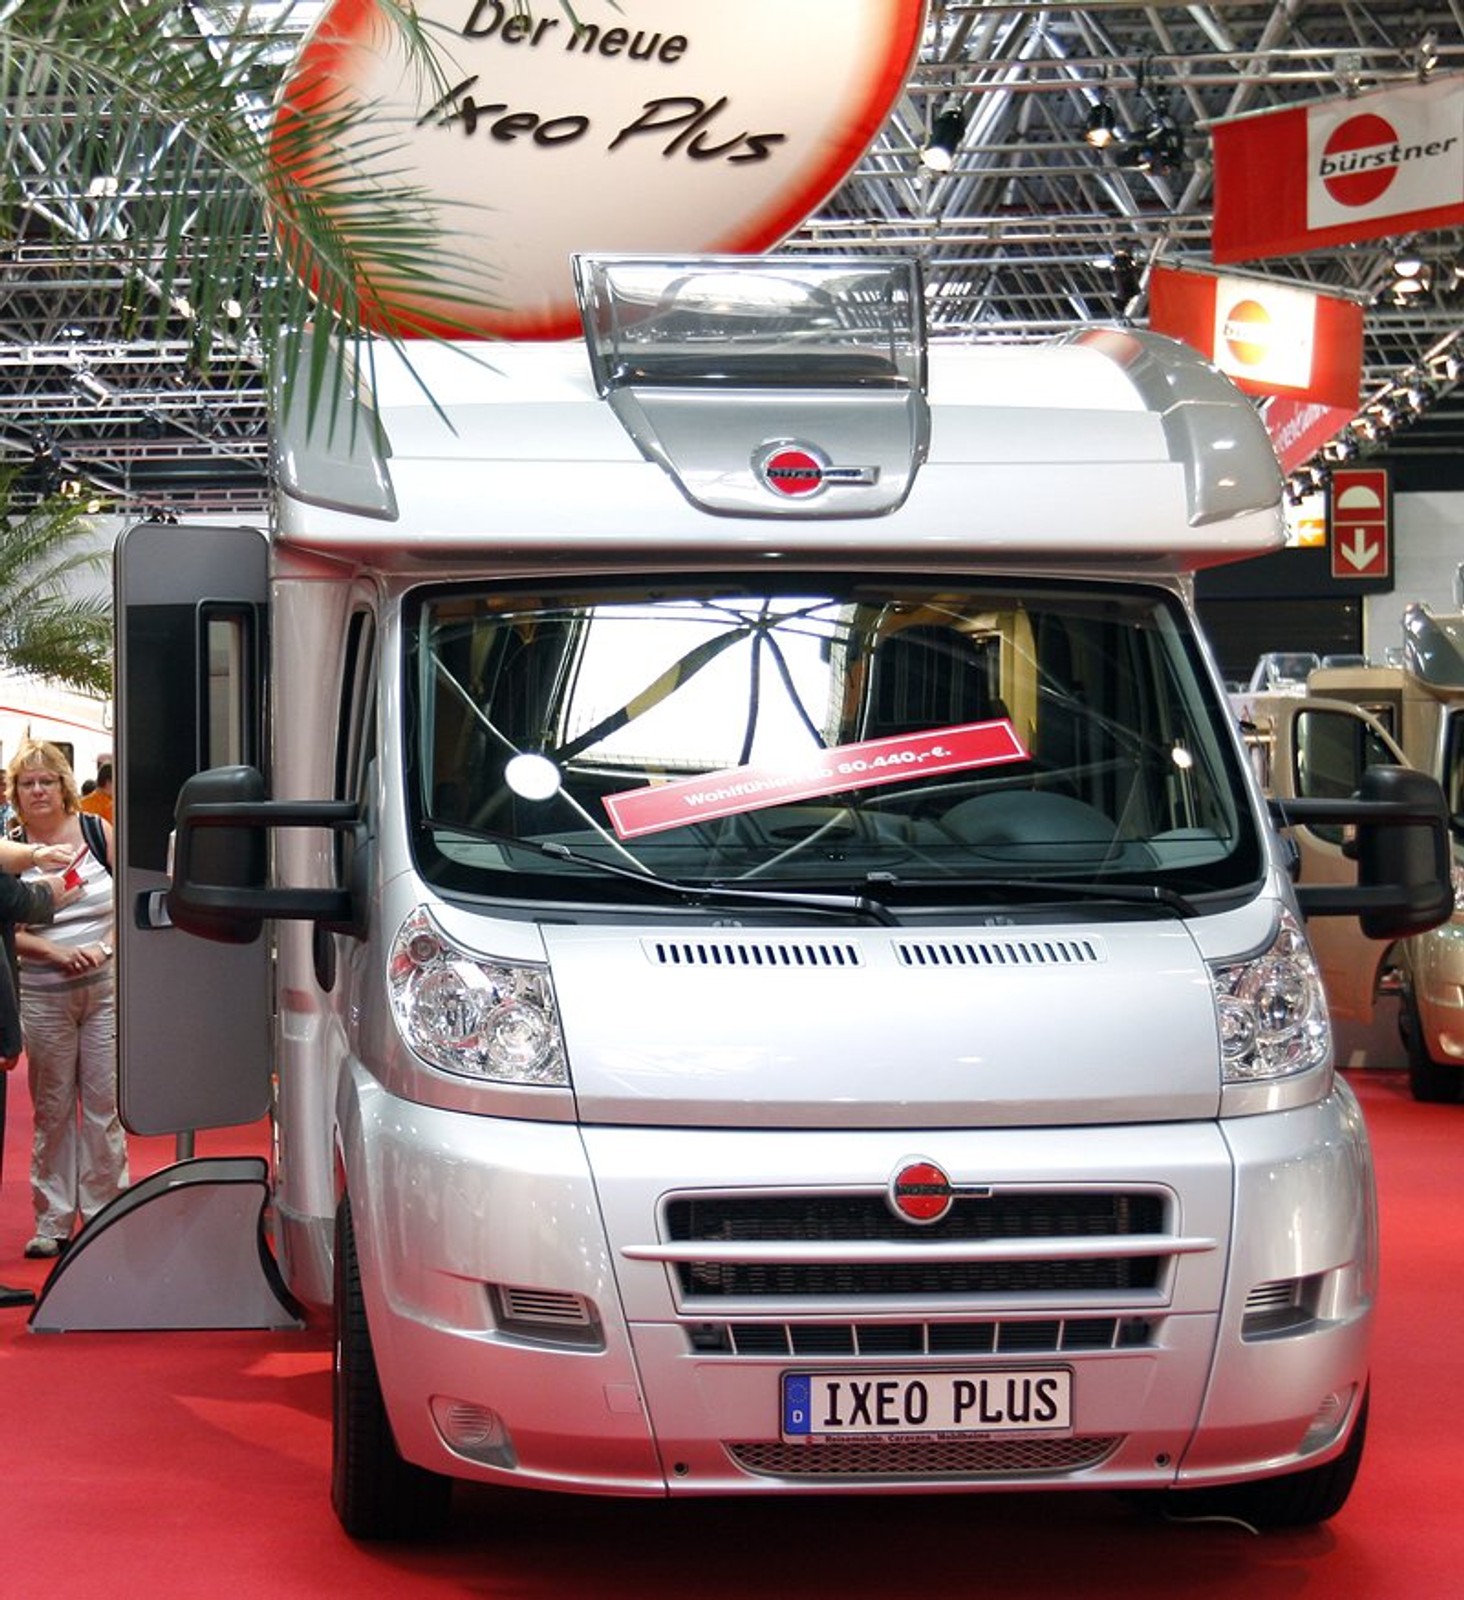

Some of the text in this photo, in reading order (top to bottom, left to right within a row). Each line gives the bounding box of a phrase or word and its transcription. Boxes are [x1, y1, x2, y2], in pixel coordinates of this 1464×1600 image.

[463, 0, 688, 65] Der neue
[416, 74, 787, 164] Ixeo Plus
[1319, 137, 1458, 177] bürstner
[824, 1378, 1058, 1426] IXEO PLUS
